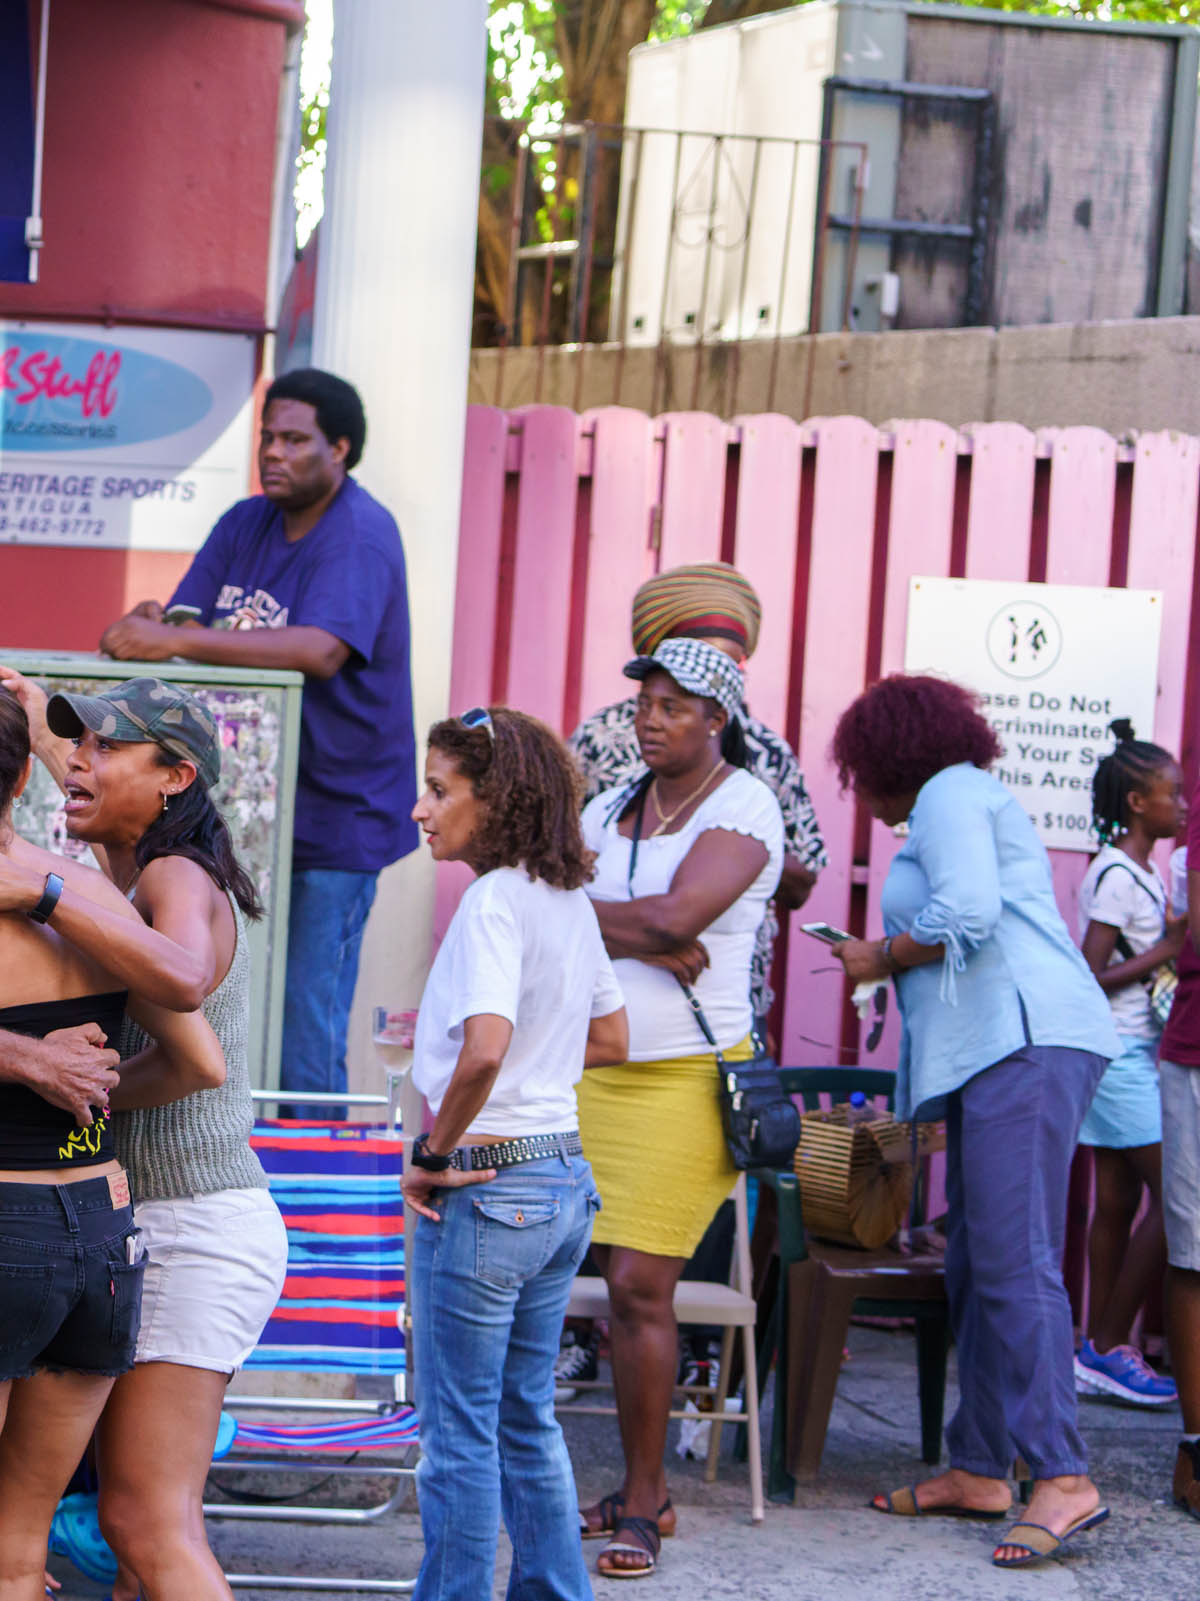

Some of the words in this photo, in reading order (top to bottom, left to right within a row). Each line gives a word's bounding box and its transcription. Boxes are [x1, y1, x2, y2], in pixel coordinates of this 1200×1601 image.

[14, 350, 122, 418] Stuff
[101, 476, 198, 503] SPORTS
[980, 692, 1020, 709] ase
[1029, 691, 1061, 711] Do
[1070, 695, 1111, 715] Not
[991, 716, 1111, 740] criminatel
[1016, 742, 1072, 763] Your
